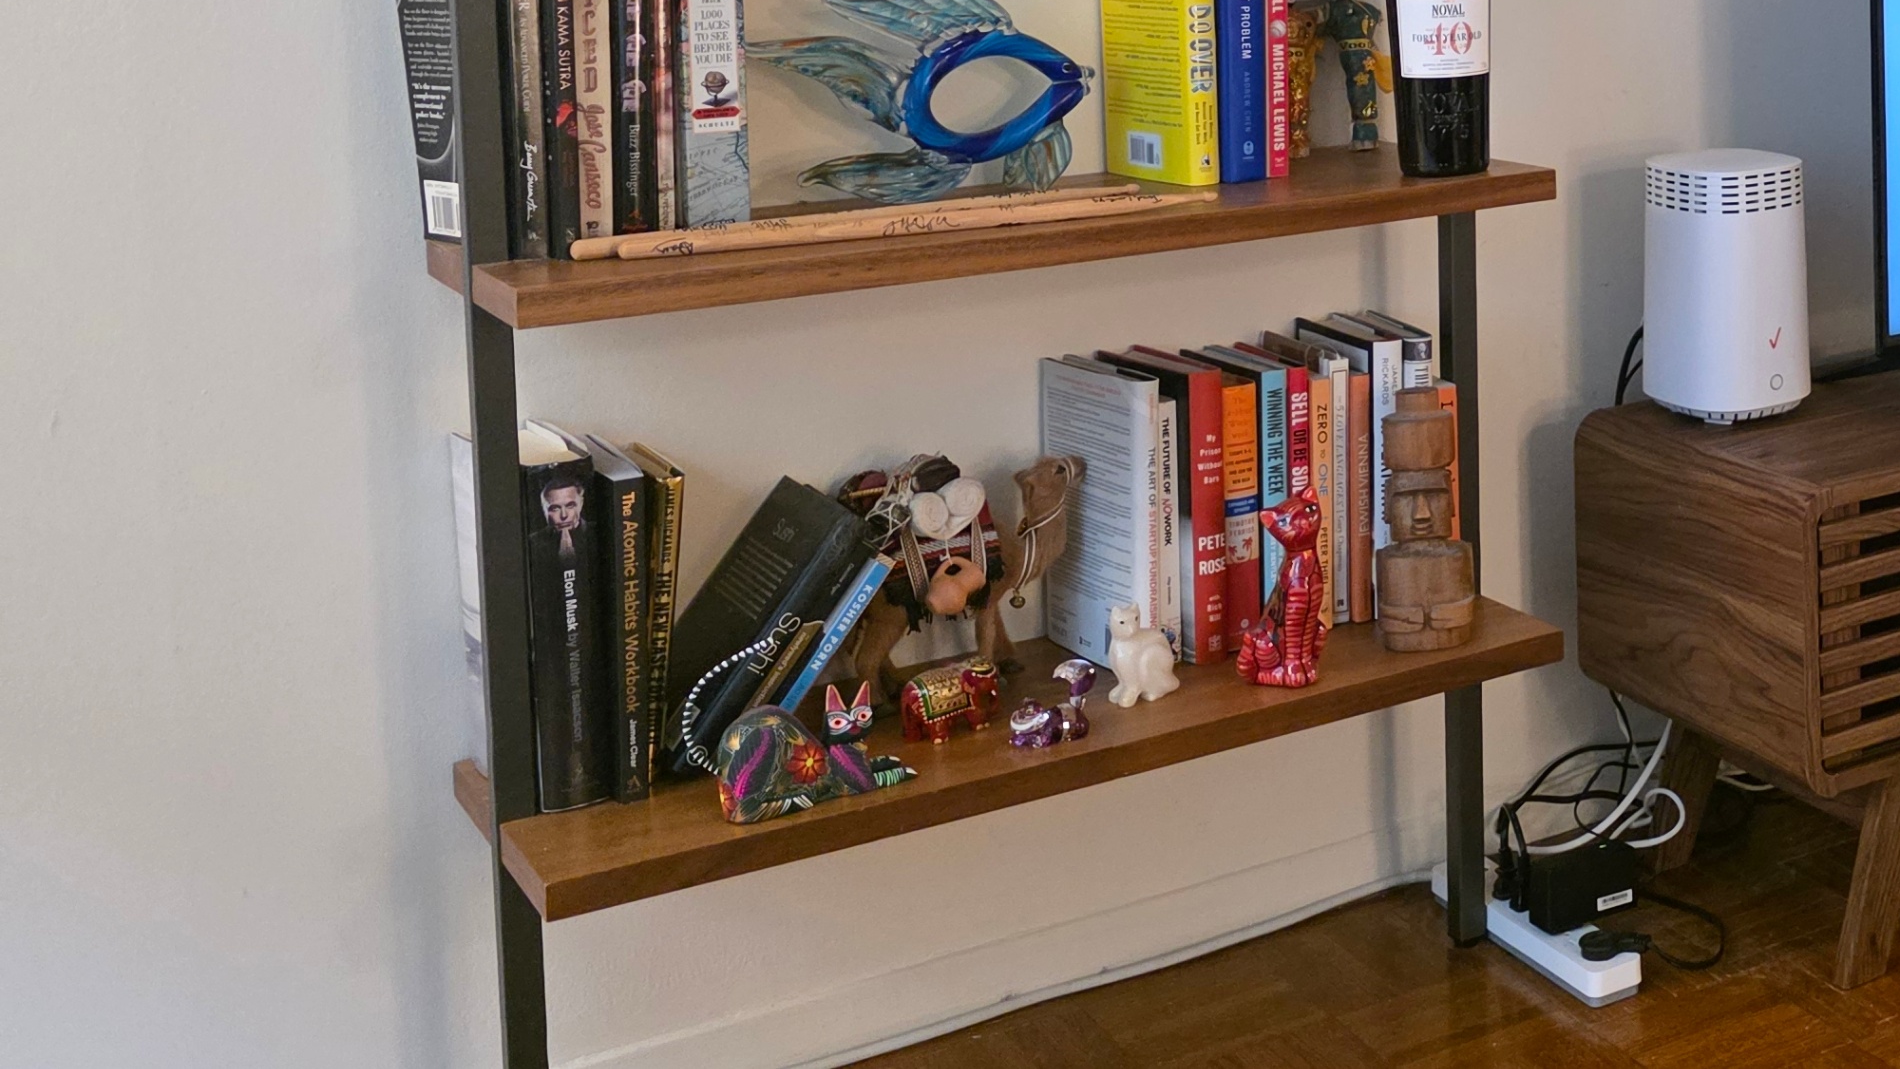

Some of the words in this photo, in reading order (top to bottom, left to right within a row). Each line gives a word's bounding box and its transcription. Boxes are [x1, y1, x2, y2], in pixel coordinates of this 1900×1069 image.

[694, 19, 731, 31] PLACES
[1188, 5, 1212, 34] DO
[1431, 3, 1466, 16] NOVAL
[556, 6, 571, 47] KAMA
[694, 32, 709, 42] TO
[710, 31, 729, 42] SEE
[1240, 6, 1252, 60] PROBLEM
[1424, 21, 1473, 56] 40
[693, 41, 733, 54] BEFORE
[694, 53, 714, 65] YOU
[715, 52, 733, 64] DIE
[557, 48, 573, 91] SUTRA
[1189, 38, 1214, 94] OVER
[1272, 43, 1286, 105] MICHAEL
[576, 103, 605, 139] Jose
[628, 124, 641, 149] Buzz
[698, 120, 735, 129] SCHULTZ
[1273, 108, 1286, 152] LEWIS
[627, 150, 641, 198] Bissinger
[1381, 357, 1390, 406] RICKARDS
[1266, 387, 1284, 439] WINNING
[1291, 391, 1308, 427] SELL
[1316, 403, 1328, 444] ZERO
[1161, 416, 1170, 439] THE
[1205, 434, 1216, 443] My
[1293, 429, 1307, 446] OR
[1147, 446, 1156, 469] THE
[1162, 439, 1171, 480] FUTURE
[1199, 447, 1221, 457] Prison
[1267, 440, 1284, 463] THE
[1293, 447, 1307, 463] BE
[1319, 449, 1326, 459] TO
[1358, 432, 1370, 486] VIENNA
[1147, 470, 1157, 494] ART
[1162, 481, 1172, 495] OF
[1203, 475, 1220, 485] Bars
[1268, 464, 1285, 496] WEEK
[1318, 463, 1329, 496] ONE
[621, 491, 636, 517] The
[1147, 494, 1157, 509] OF
[1358, 489, 1370, 538] JEWISH
[622, 520, 639, 577] Atomic
[661, 518, 676, 564] RICKARDS
[1148, 510, 1157, 558] STARTUP
[1197, 533, 1226, 552] PETE
[1320, 526, 1329, 559] PETER
[1198, 556, 1227, 576] ROSE
[563, 569, 576, 598] Elon
[655, 569, 674, 597] THE
[565, 598, 579, 632] Musk
[624, 579, 641, 631] Habits
[652, 599, 671, 636] NEW
[836, 583, 875, 633] KOSHER
[565, 632, 580, 648] by
[650, 637, 669, 673] CASE
[747, 611, 802, 677] Sushi
[810, 634, 839, 672] PORN
[569, 649, 581, 687] Walter
[624, 633, 640, 714] Workbook
[571, 688, 583, 743] Isaacson
[629, 718, 638, 745] James
[629, 745, 639, 768] Clear
